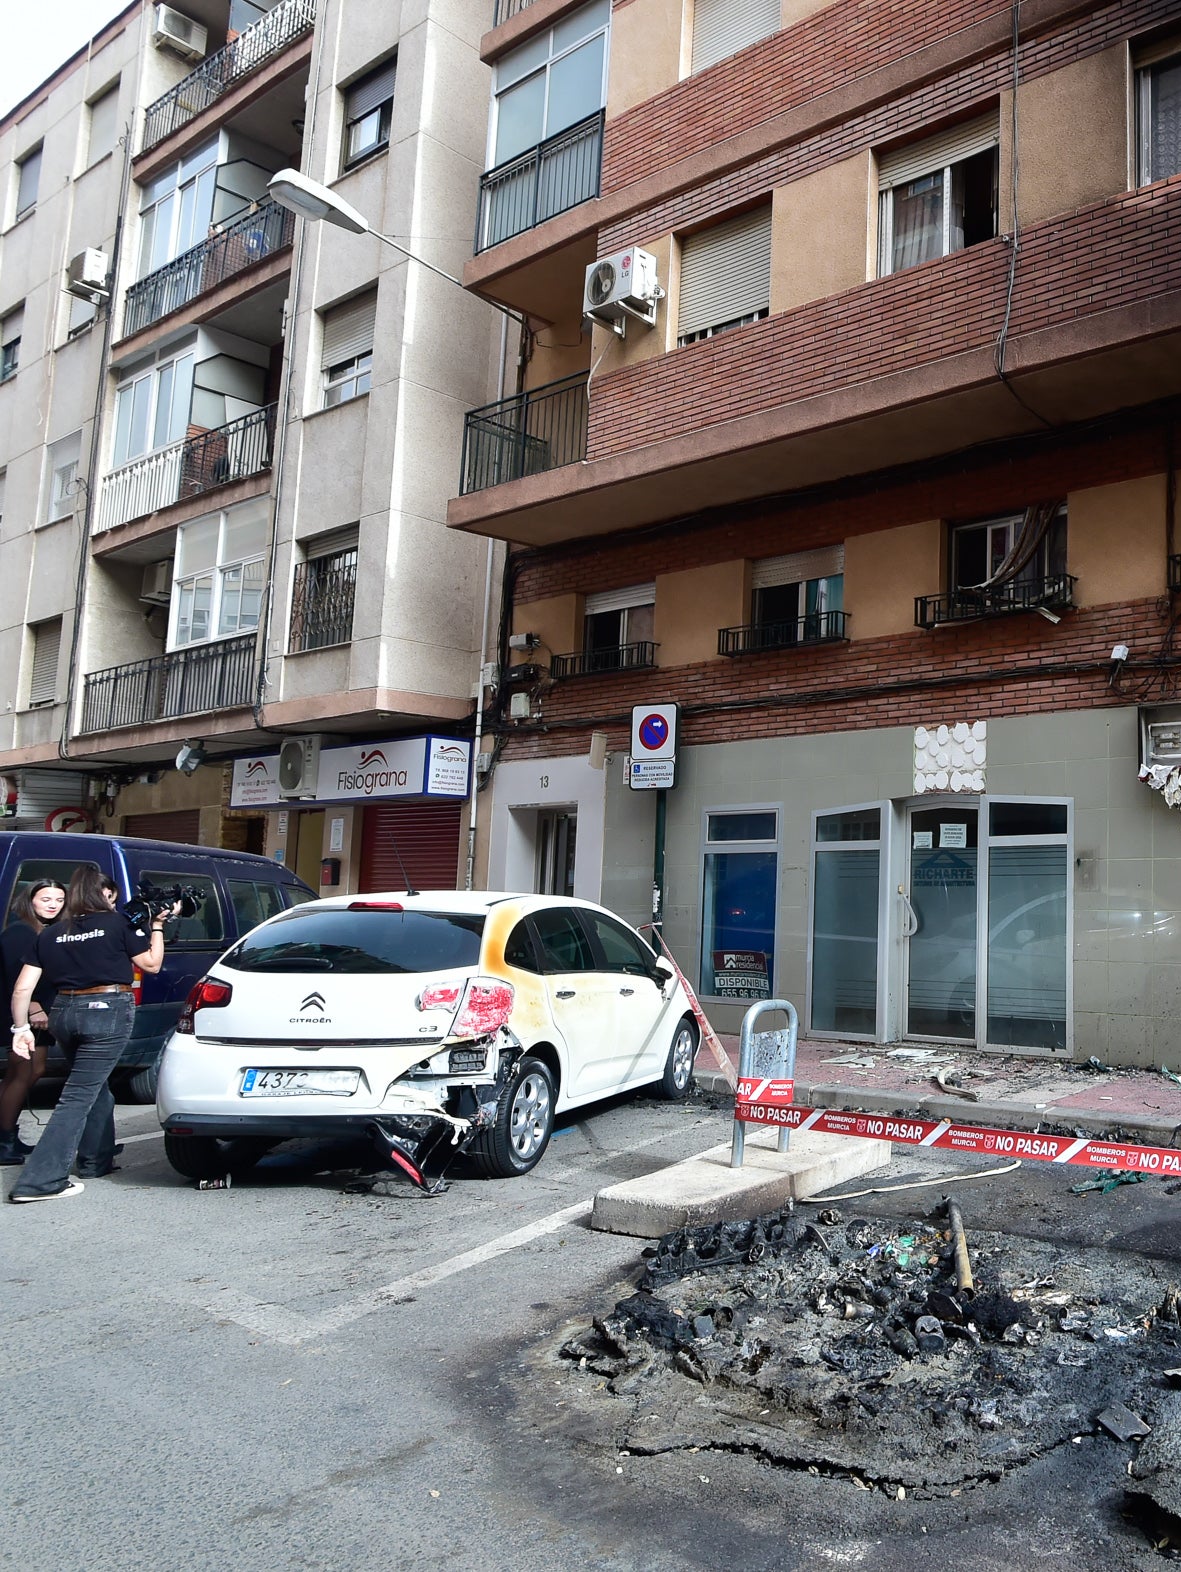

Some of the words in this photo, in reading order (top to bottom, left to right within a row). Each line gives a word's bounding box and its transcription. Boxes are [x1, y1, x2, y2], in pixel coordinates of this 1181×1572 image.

[621, 270, 629, 278] LG
[433, 753, 467, 763] Fisiograna
[337, 770, 408, 795] Fisiograna
[540, 775, 549, 789] 13
[914, 868, 974, 880] RICHARTE
[55, 928, 105, 943] sinopsis
[736, 961, 763, 970] residencial
[718, 978, 768, 989] DISPONIBLE
[721, 989, 738, 998] 655
[739, 989, 749, 998] 96
[750, 1105, 765, 1119] NO
[767, 1107, 801, 1124] PASAR
[823, 1114, 857, 1123] BOMBEROS
[827, 1122, 850, 1131] MURCIA
[866, 1121, 883, 1135] NO
[885, 1122, 923, 1140] PASAR
[948, 1129, 984, 1140] BOMBEROS
[951, 1138, 977, 1147] MURCIA
[995, 1135, 1014, 1151] NO
[1016, 1138, 1059, 1157] PASAR
[1086, 1145, 1126, 1157] BOMBEROS
[1089, 1155, 1118, 1164] MURCIA
[1139, 1152, 1159, 1169] NO
